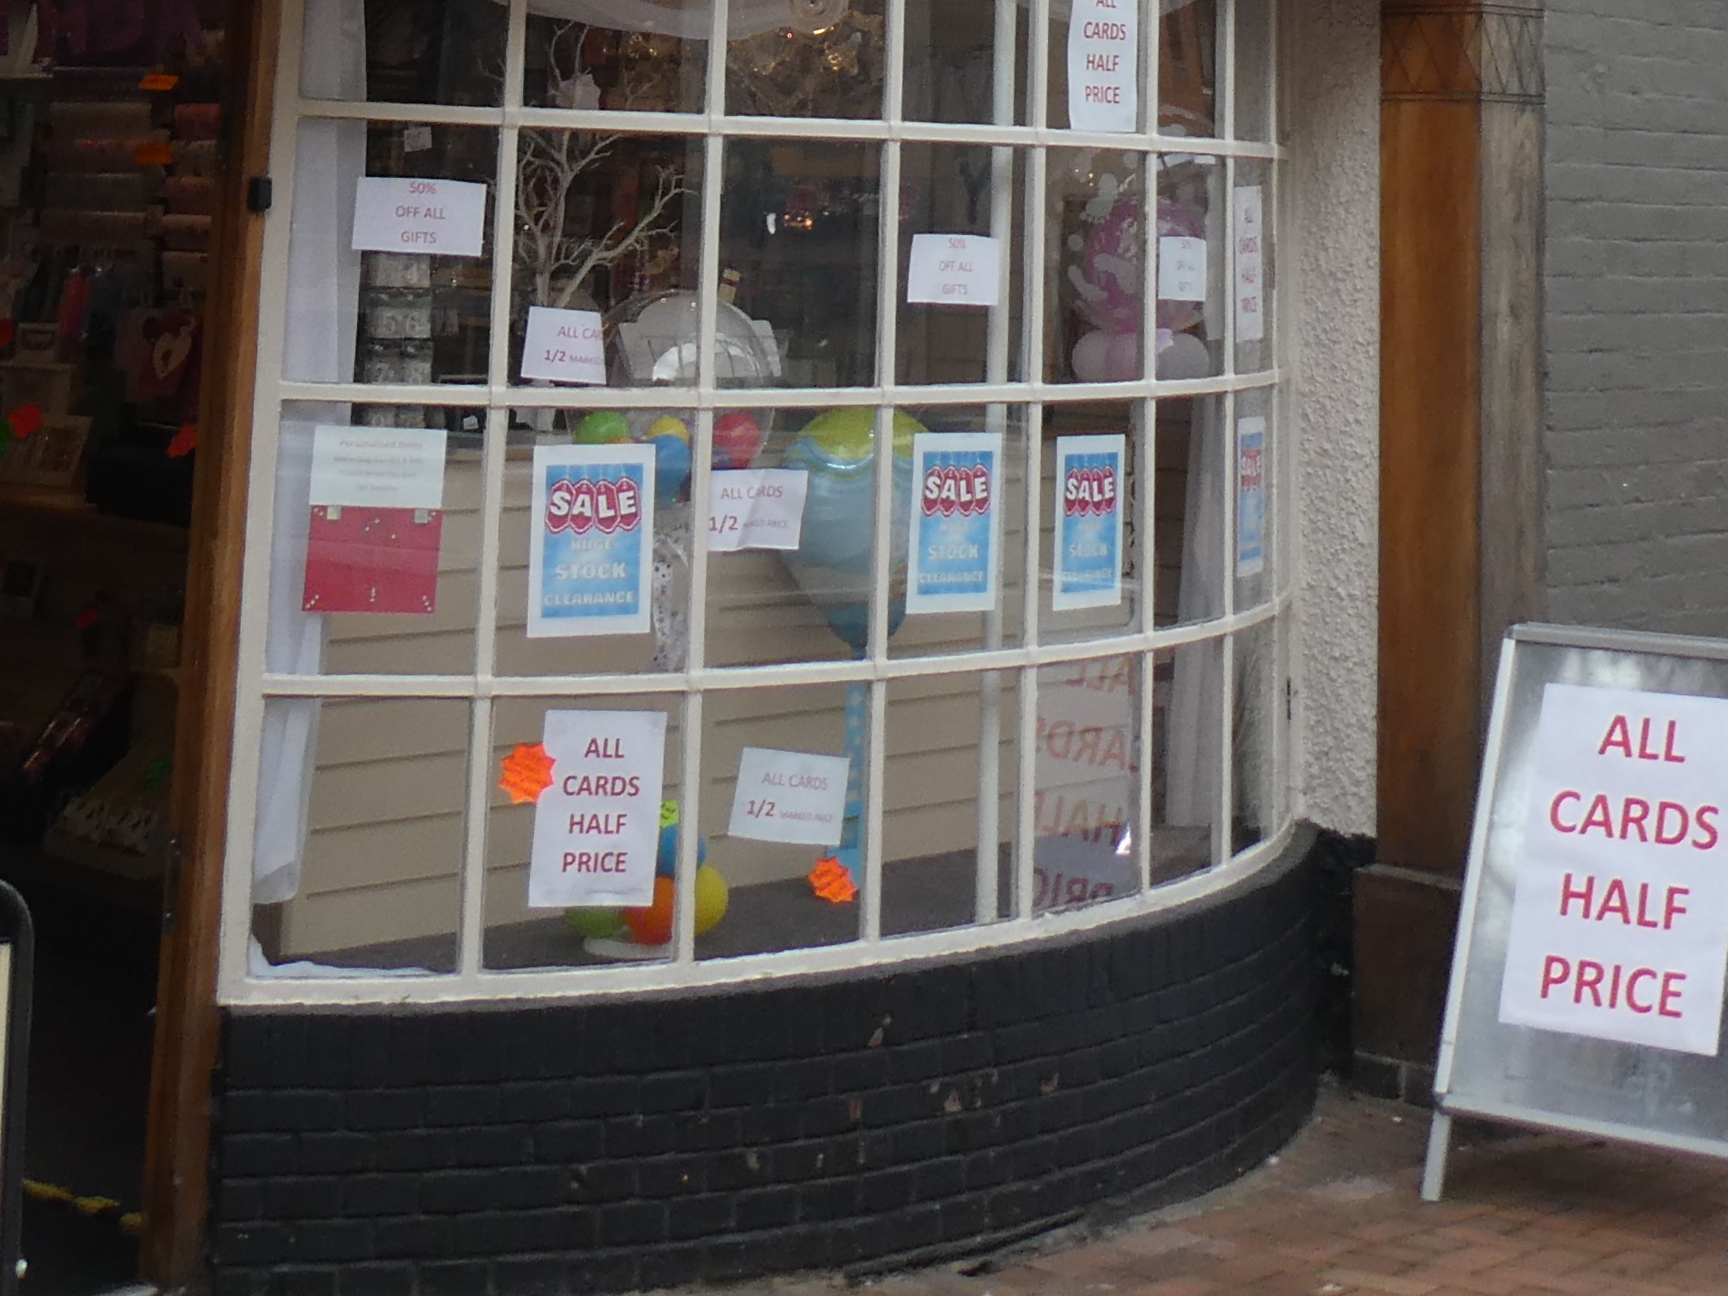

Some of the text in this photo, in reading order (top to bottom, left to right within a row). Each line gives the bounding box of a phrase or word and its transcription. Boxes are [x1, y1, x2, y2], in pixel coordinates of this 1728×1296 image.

[1083, 21, 1127, 41] CARDS
[1085, 53, 1120, 72] HALF
[1084, 85, 1121, 104] PRICE
[395, 205, 446, 220] OFF ALL
[400, 230, 437, 244] GIFTS
[557, 325, 579, 339] ALL
[543, 349, 566, 363] 1/2
[720, 487, 743, 500] ALL
[924, 475, 988, 503] SALE
[1064, 476, 1115, 503] SALE
[549, 489, 637, 519] SALE
[708, 514, 739, 534] 1/2
[927, 543, 980, 561] STOCK
[555, 561, 627, 581] STOCK
[543, 590, 635, 607] CLEARANCE
[584, 737, 625, 759] ALL
[1597, 714, 1686, 764] ALL
[562, 775, 640, 797] CARDS
[761, 771, 829, 791] ALL CARDS
[746, 798, 776, 819] 1/2
[568, 813, 628, 835] HALF
[1549, 789, 1720, 851] CARDS
[561, 851, 628, 874] PRICE
[1559, 872, 1690, 931] HALF
[1540, 954, 1688, 1019] PRICE
